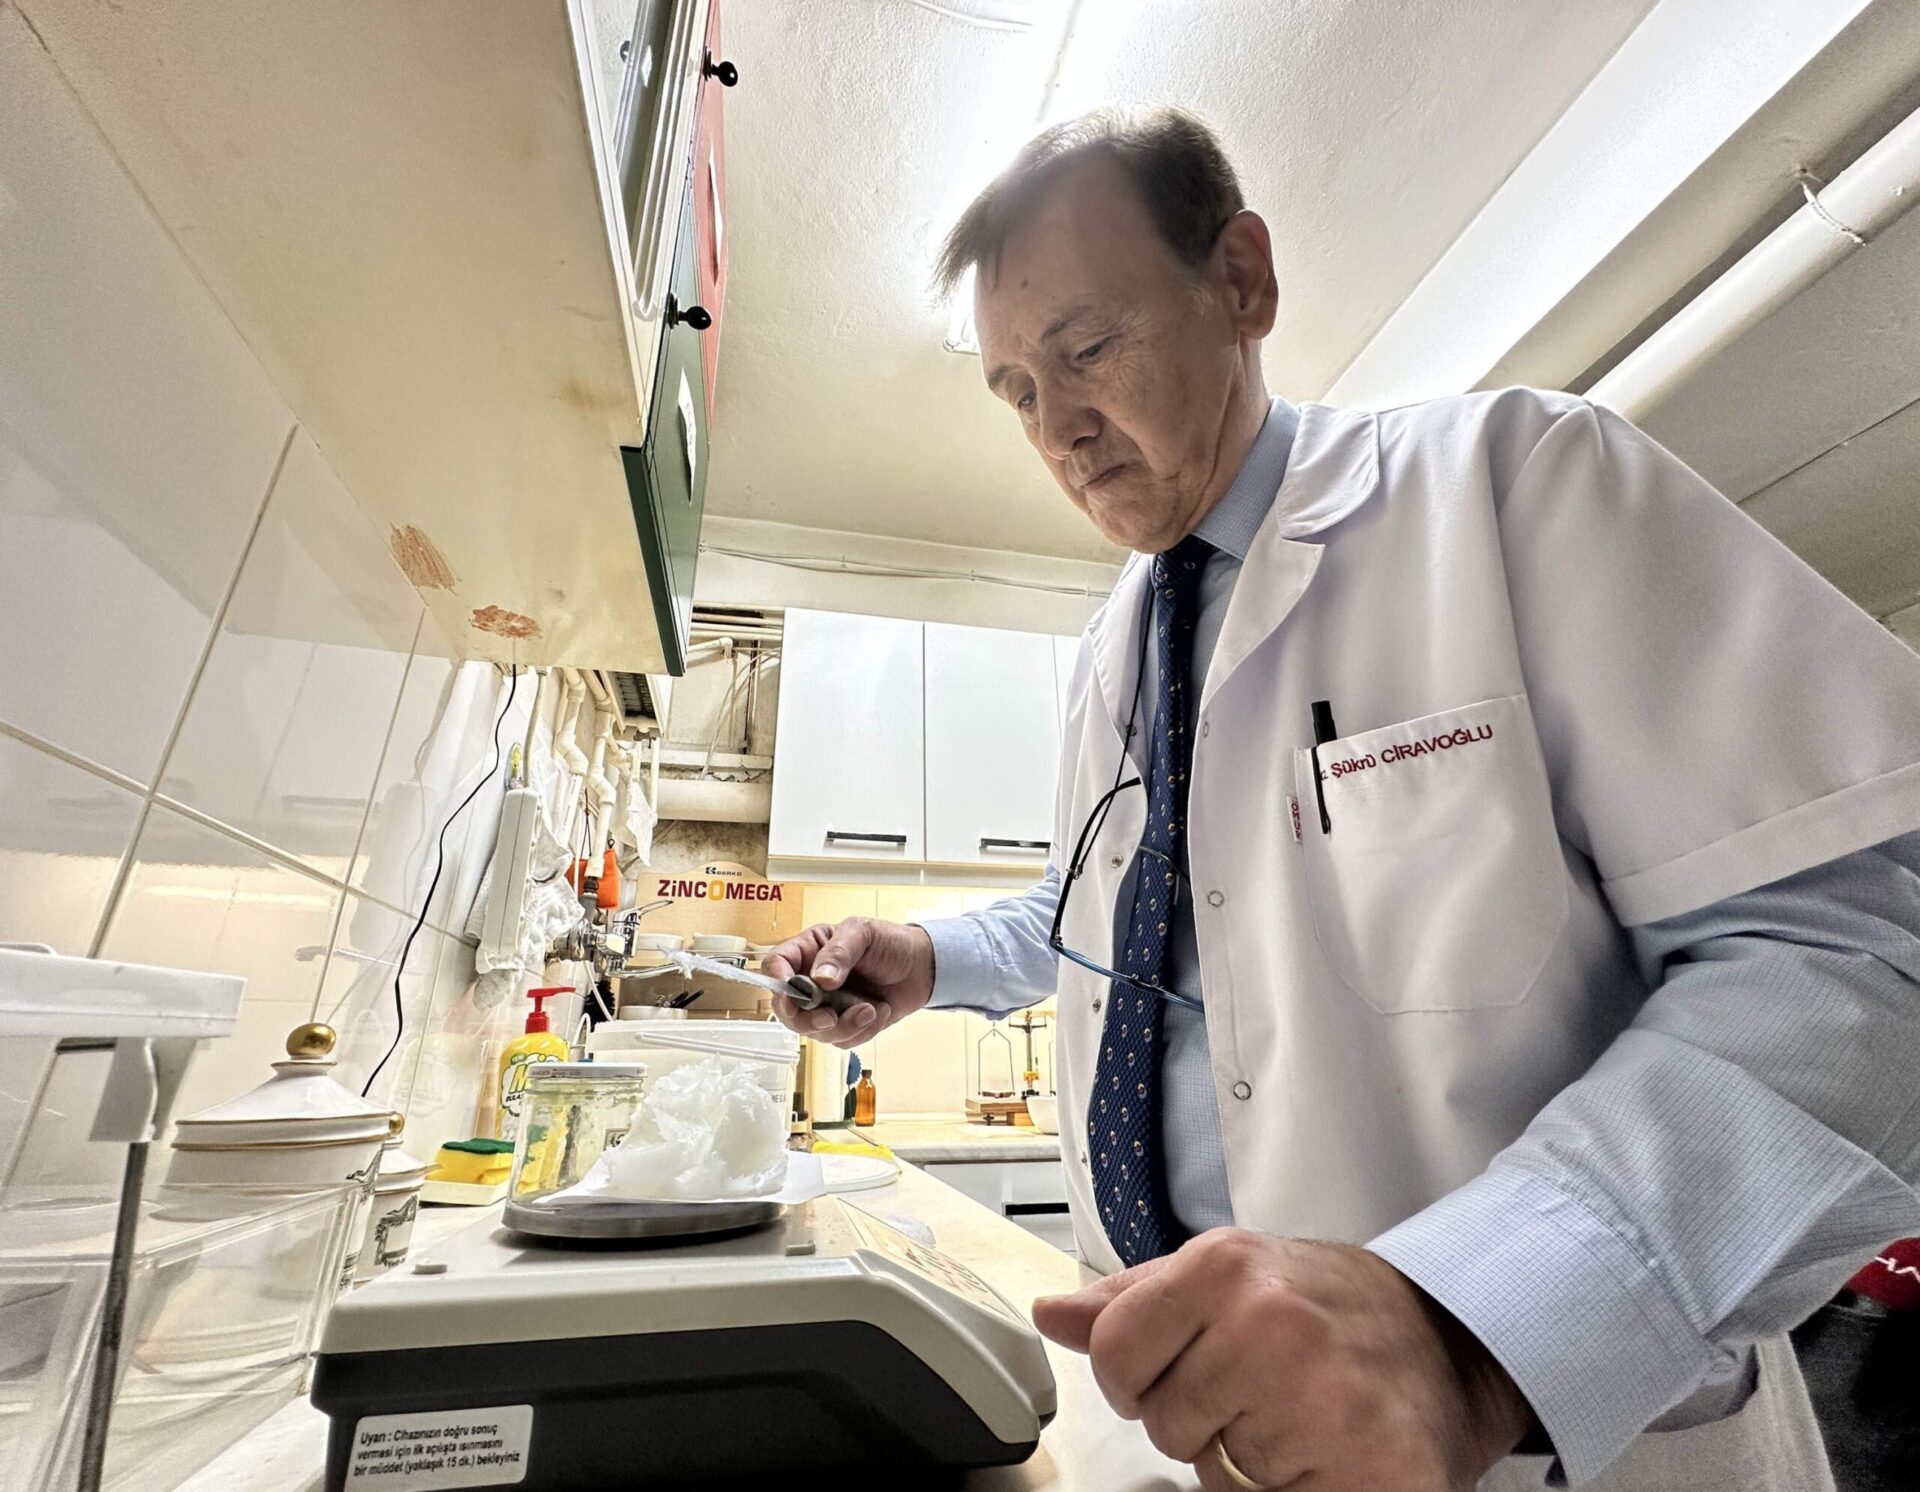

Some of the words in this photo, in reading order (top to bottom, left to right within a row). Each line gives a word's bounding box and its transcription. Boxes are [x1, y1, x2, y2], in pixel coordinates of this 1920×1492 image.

[1381, 724, 1494, 764] CİRAVOĞLU
[443, 1425, 469, 1439] doğru
[470, 1424, 498, 1436] sonuç
[353, 1464, 367, 1477] bir
[367, 1461, 404, 1475] müddet
[446, 1456, 457, 1468] 15
[476, 1450, 520, 1467] bekleyiniz
